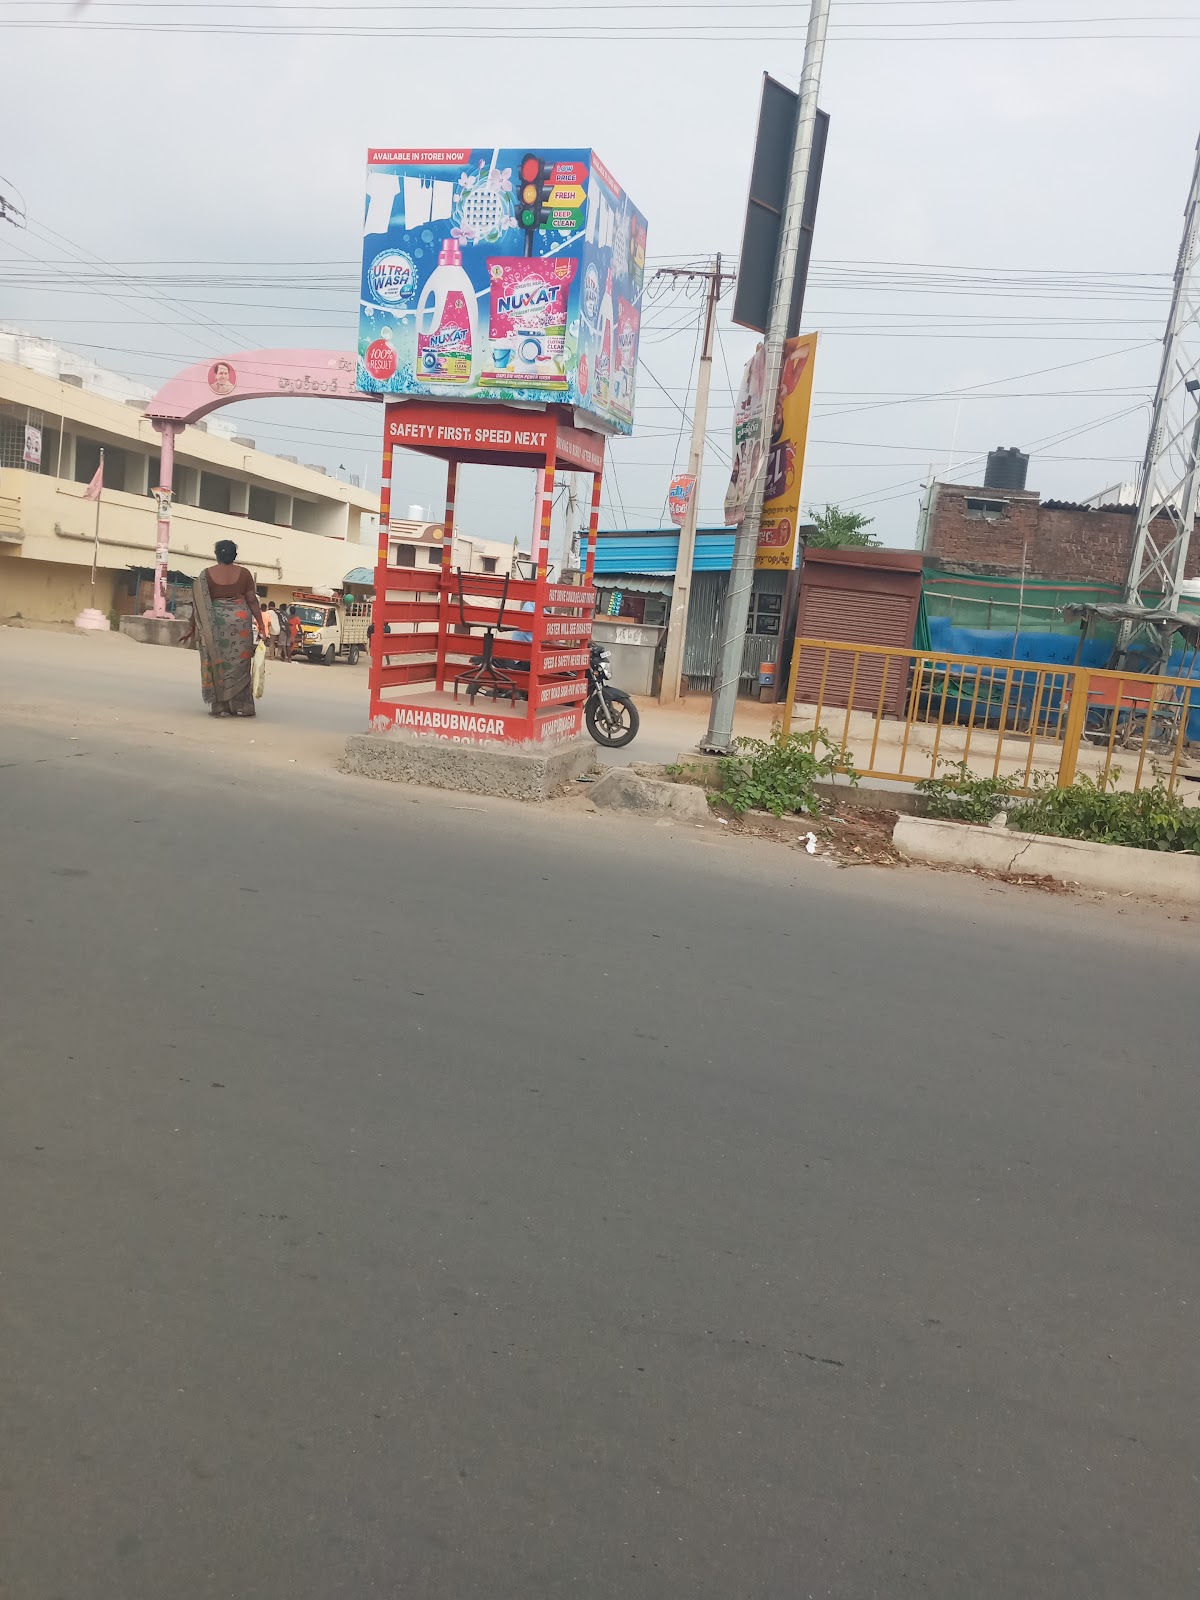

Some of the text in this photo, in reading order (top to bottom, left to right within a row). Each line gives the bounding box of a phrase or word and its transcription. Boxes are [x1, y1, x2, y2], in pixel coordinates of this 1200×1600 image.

[372, 152, 410, 160] AVAILABLE
[421, 152, 444, 160] STORES
[373, 264, 410, 277] ULTRA
[374, 276, 409, 290] WASH
[497, 285, 561, 314] NUXAT
[430, 330, 468, 346] NUXAT
[370, 348, 393, 360] 100%
[370, 360, 392, 370] RESULT
[390, 422, 548, 446] SAFETY FIRST, SPEED NEXT
[544, 657, 554, 670] SPEED
[558, 656, 570, 668] SAFETY
[395, 708, 504, 736] MAHABUBNAGAR
